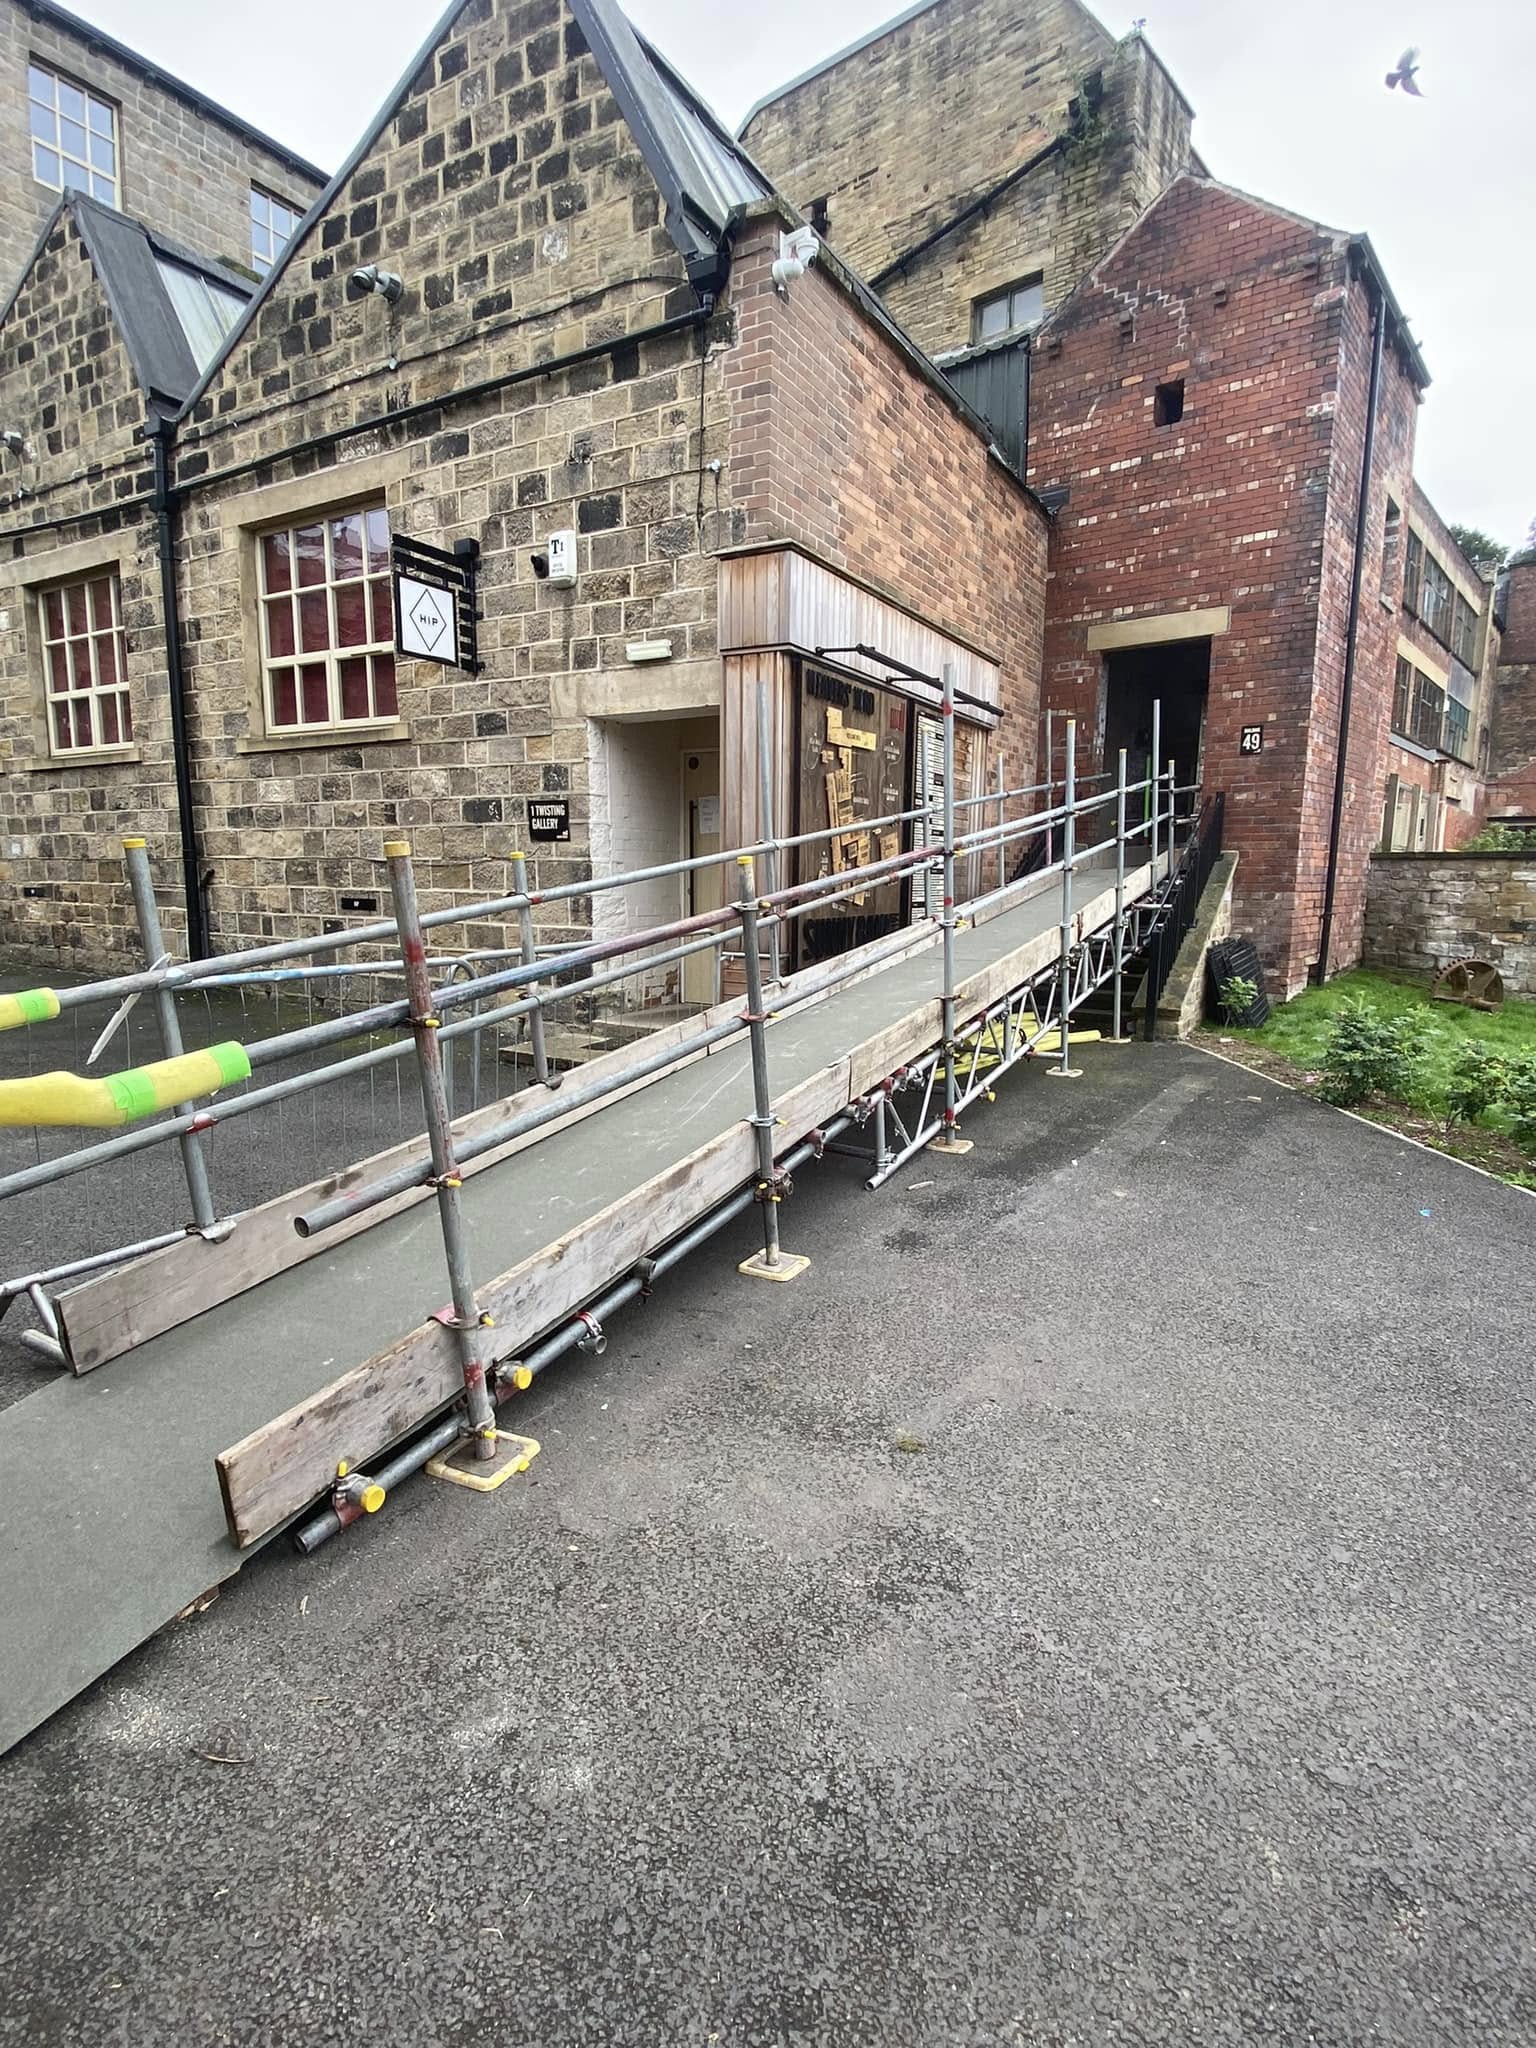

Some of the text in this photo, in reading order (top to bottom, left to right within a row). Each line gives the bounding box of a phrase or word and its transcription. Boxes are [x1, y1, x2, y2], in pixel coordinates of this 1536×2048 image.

[420, 614, 438, 626] HIP
[1242, 733, 1260, 750] 49
[535, 804, 566, 816] TWISTING
[532, 818, 559, 830] GALLERY
